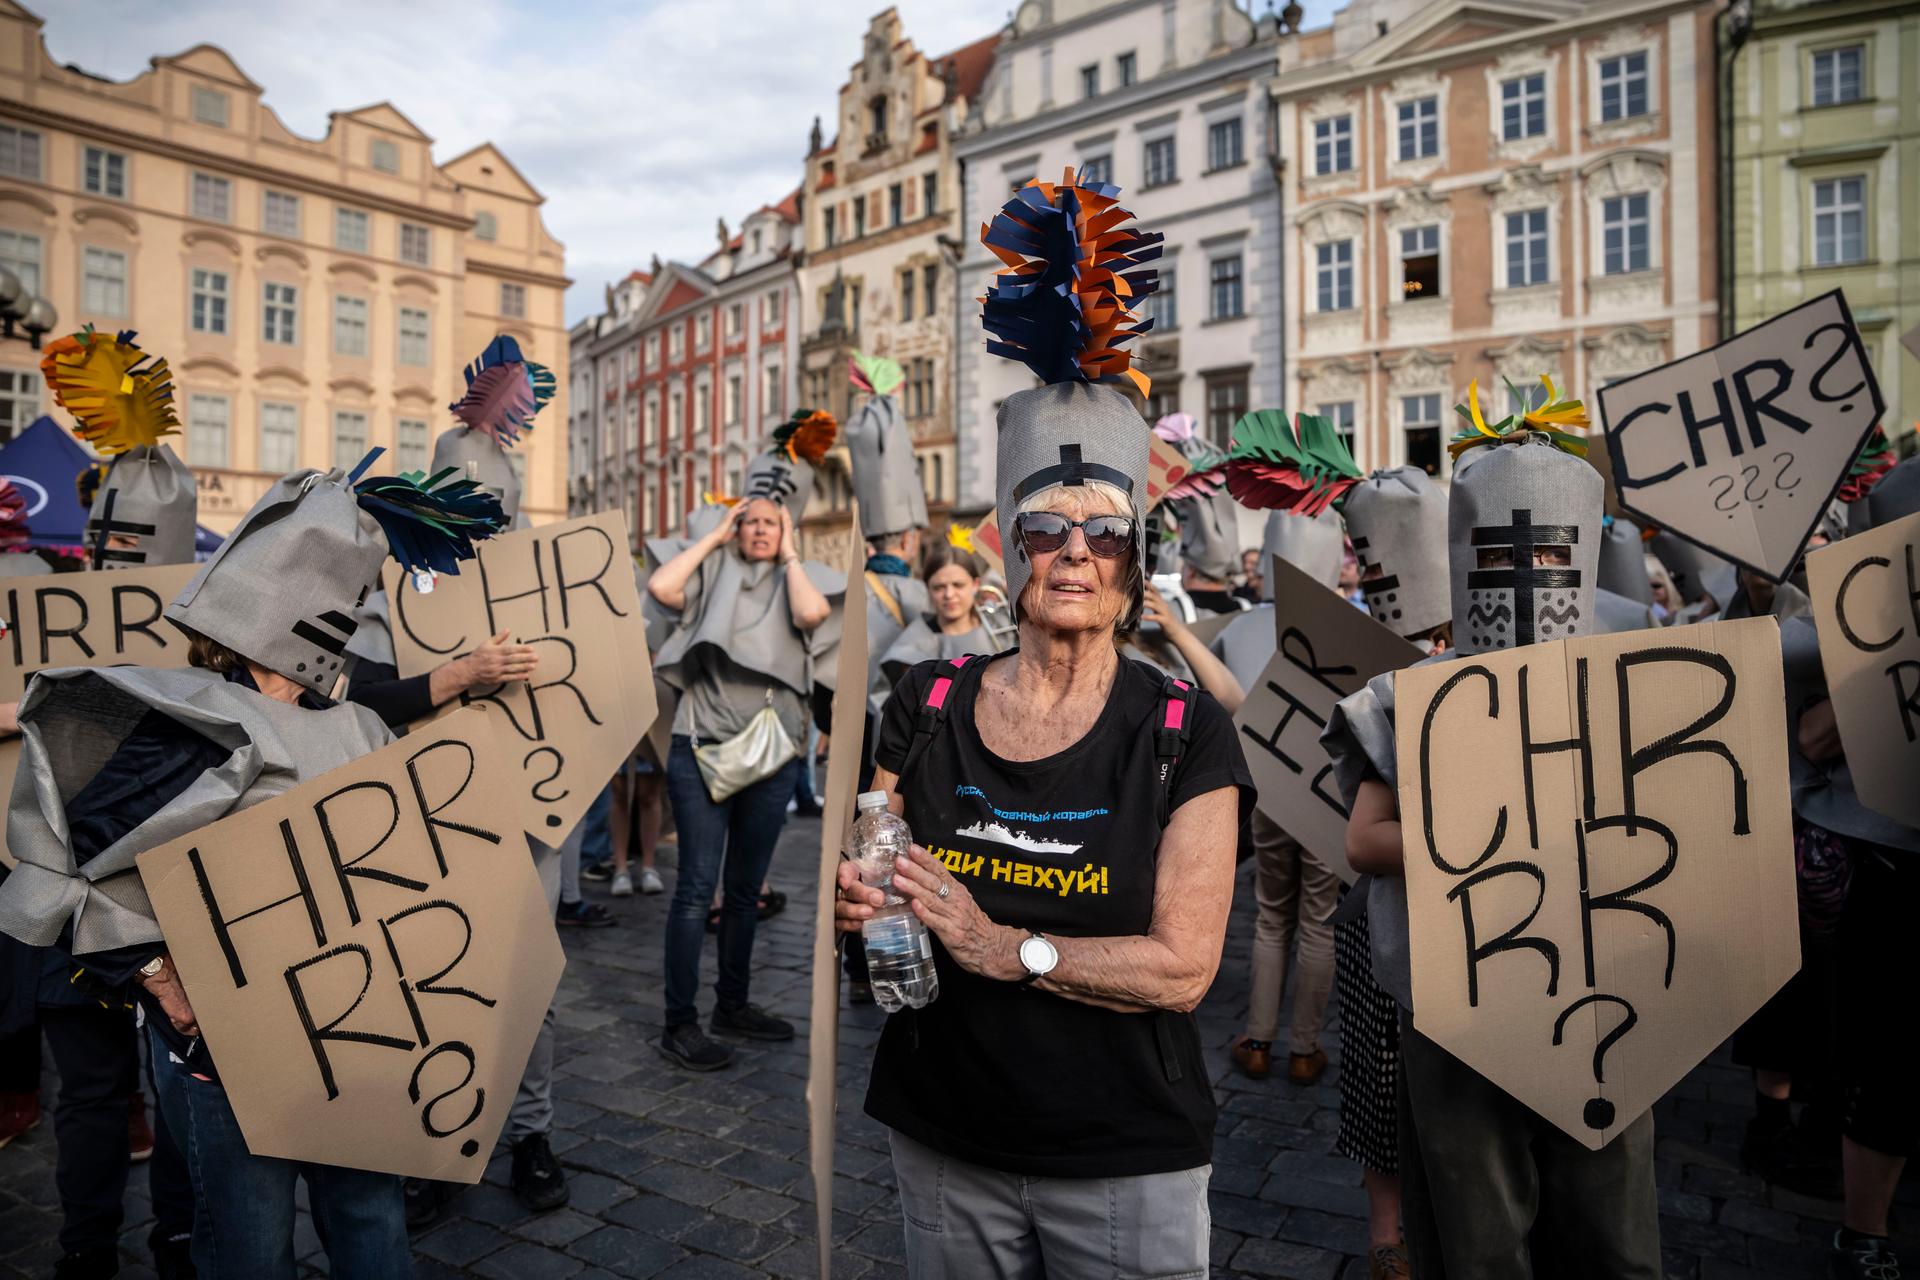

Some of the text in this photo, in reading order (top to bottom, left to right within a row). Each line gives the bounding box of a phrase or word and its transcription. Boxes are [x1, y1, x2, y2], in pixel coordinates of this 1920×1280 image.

[1607, 322, 1867, 490] CHR?
[396, 526, 628, 654] CHR
[523, 746, 569, 828] ?
[1420, 646, 1751, 876] CHR
[187, 740, 502, 989] HRR
[991, 857, 1110, 898] нахуй!
[1447, 814, 1679, 1008] RR
[283, 900, 497, 1102] RR
[1552, 993, 1638, 1131] ?
[407, 1040, 486, 1158] ?
